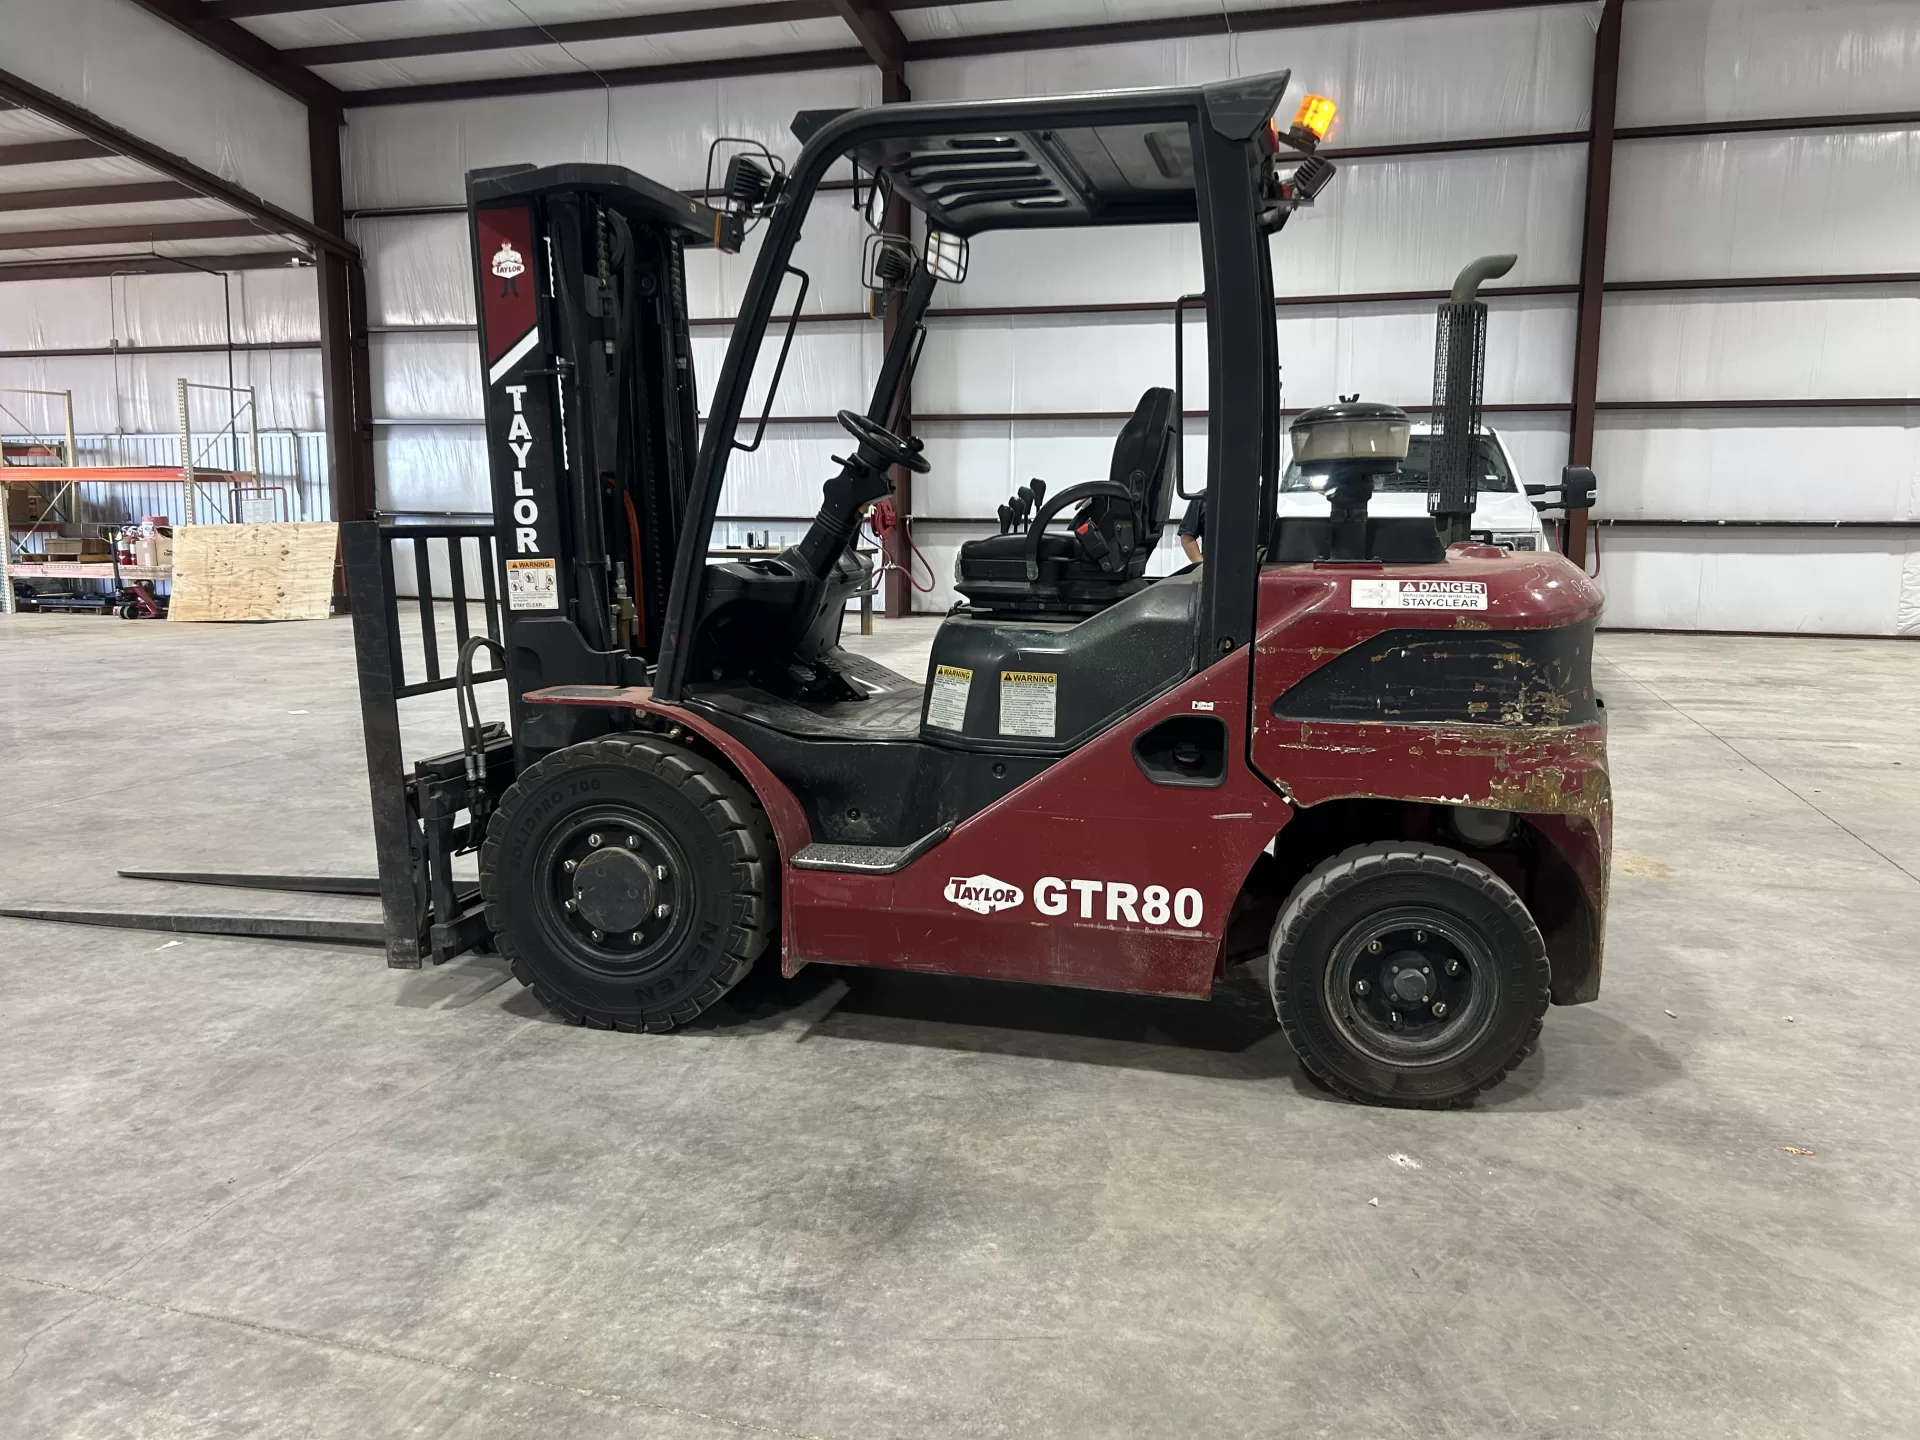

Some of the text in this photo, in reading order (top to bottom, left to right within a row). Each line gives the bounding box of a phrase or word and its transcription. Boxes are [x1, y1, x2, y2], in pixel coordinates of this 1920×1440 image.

[496, 264, 522, 273] TAYLOR
[506, 385, 540, 553] TAYLOR
[1420, 582, 1482, 593] DANGER
[1436, 599, 1478, 607] CLEAR
[944, 668, 970, 680] WARNING
[1013, 674, 1054, 684] WARNING
[509, 778, 601, 870] SOLIDPRO 700
[951, 879, 1017, 903] TAYLOR
[1033, 876, 1204, 928] GTR80
[632, 919, 719, 1004] NEXEN
